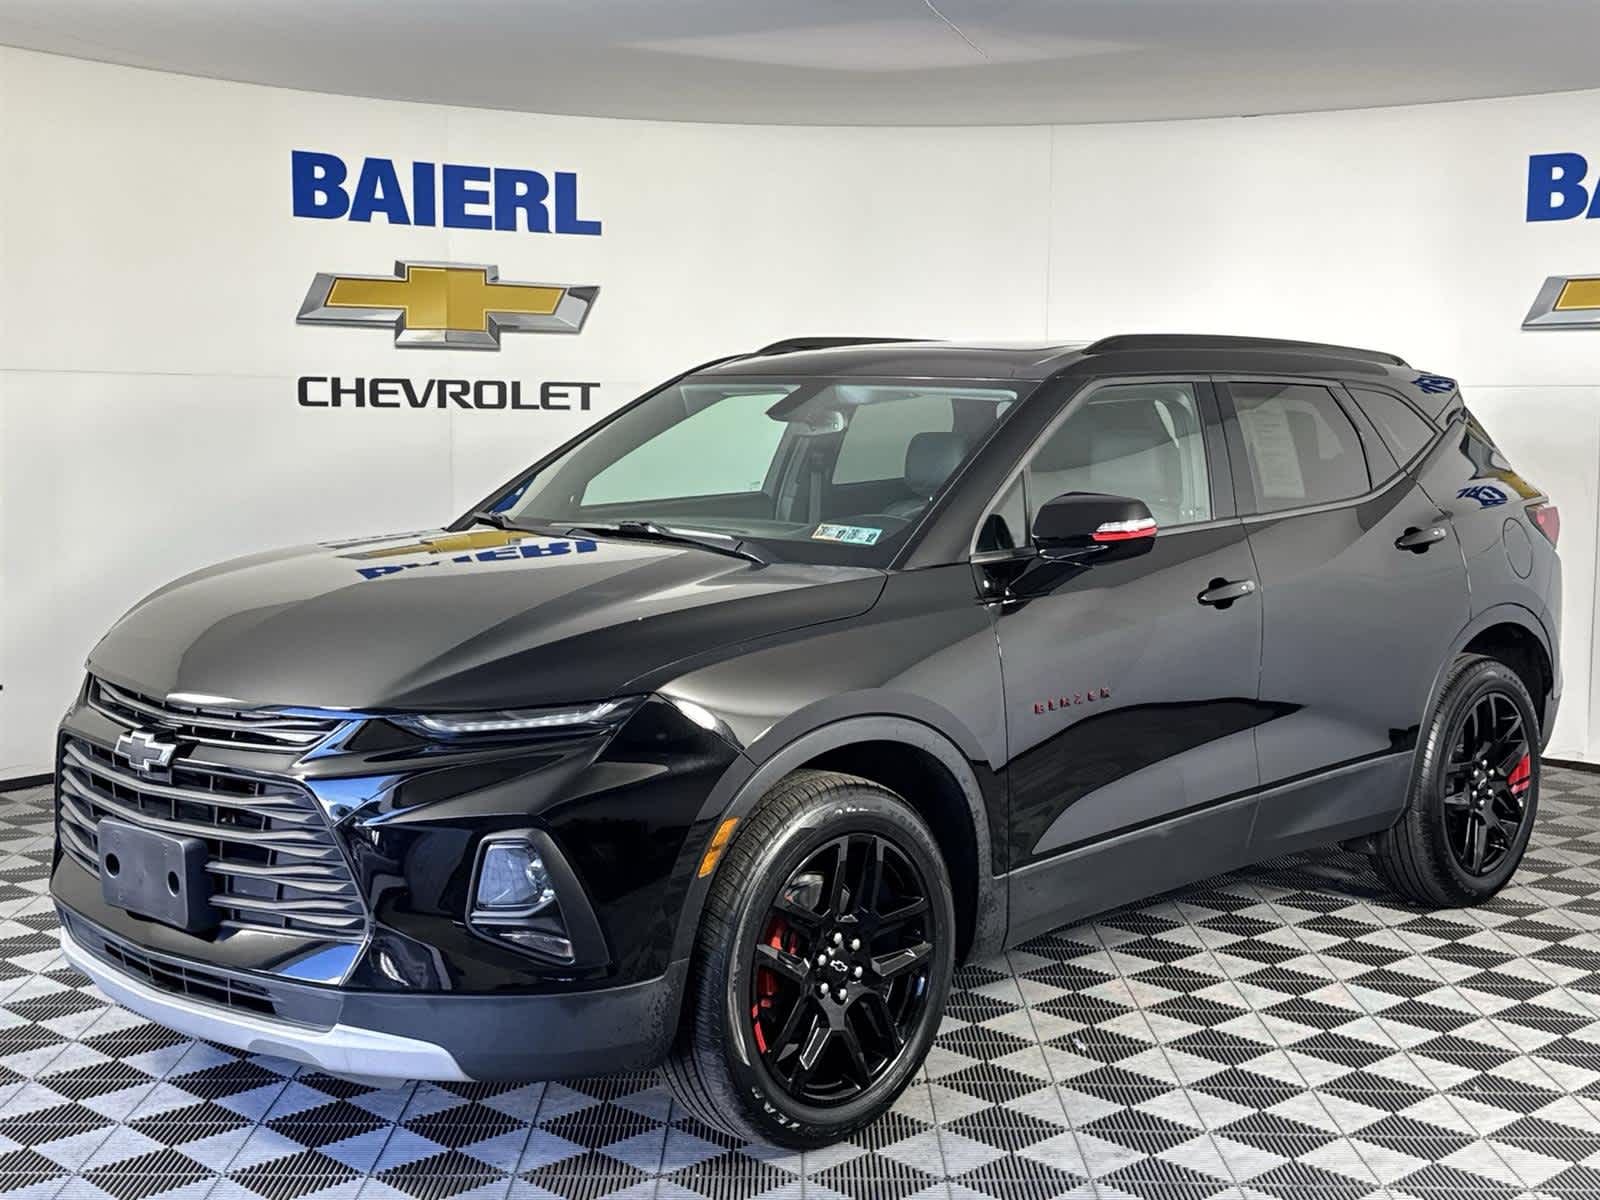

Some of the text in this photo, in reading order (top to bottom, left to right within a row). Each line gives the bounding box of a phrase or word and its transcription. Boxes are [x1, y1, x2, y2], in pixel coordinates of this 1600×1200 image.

[291, 150, 602, 236] BAIERL
[298, 376, 600, 411] CHEVROLET
[1034, 688, 1110, 715] BLAZER
